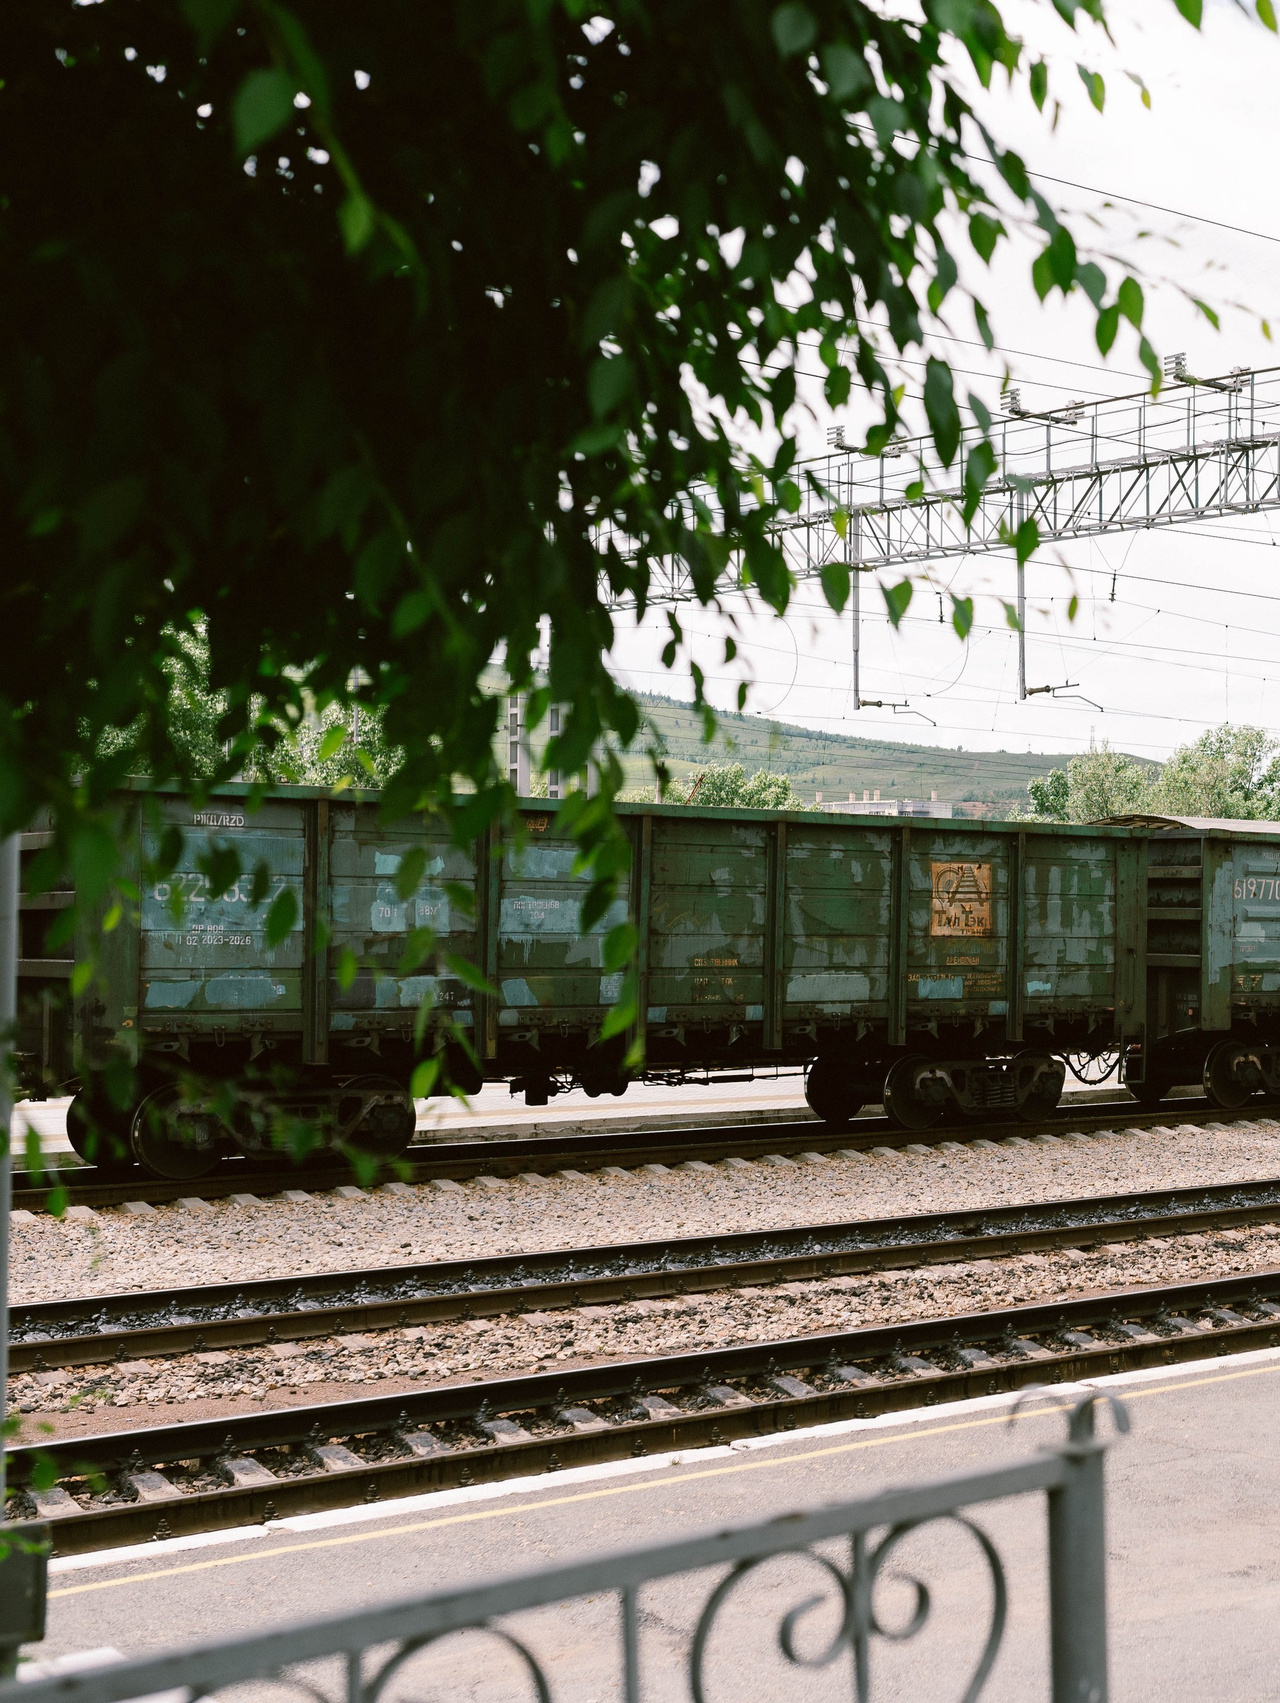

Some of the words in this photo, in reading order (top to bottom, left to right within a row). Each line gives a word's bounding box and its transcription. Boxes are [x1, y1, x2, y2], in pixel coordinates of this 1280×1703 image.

[193, 814, 245, 827] РЖД/RZD
[378, 907, 391, 918] 70
[191, 924, 204, 934] ДР
[206, 924, 224, 934] 809
[186, 936, 198, 946] 02
[201, 935, 252, 946] 2023-2026
